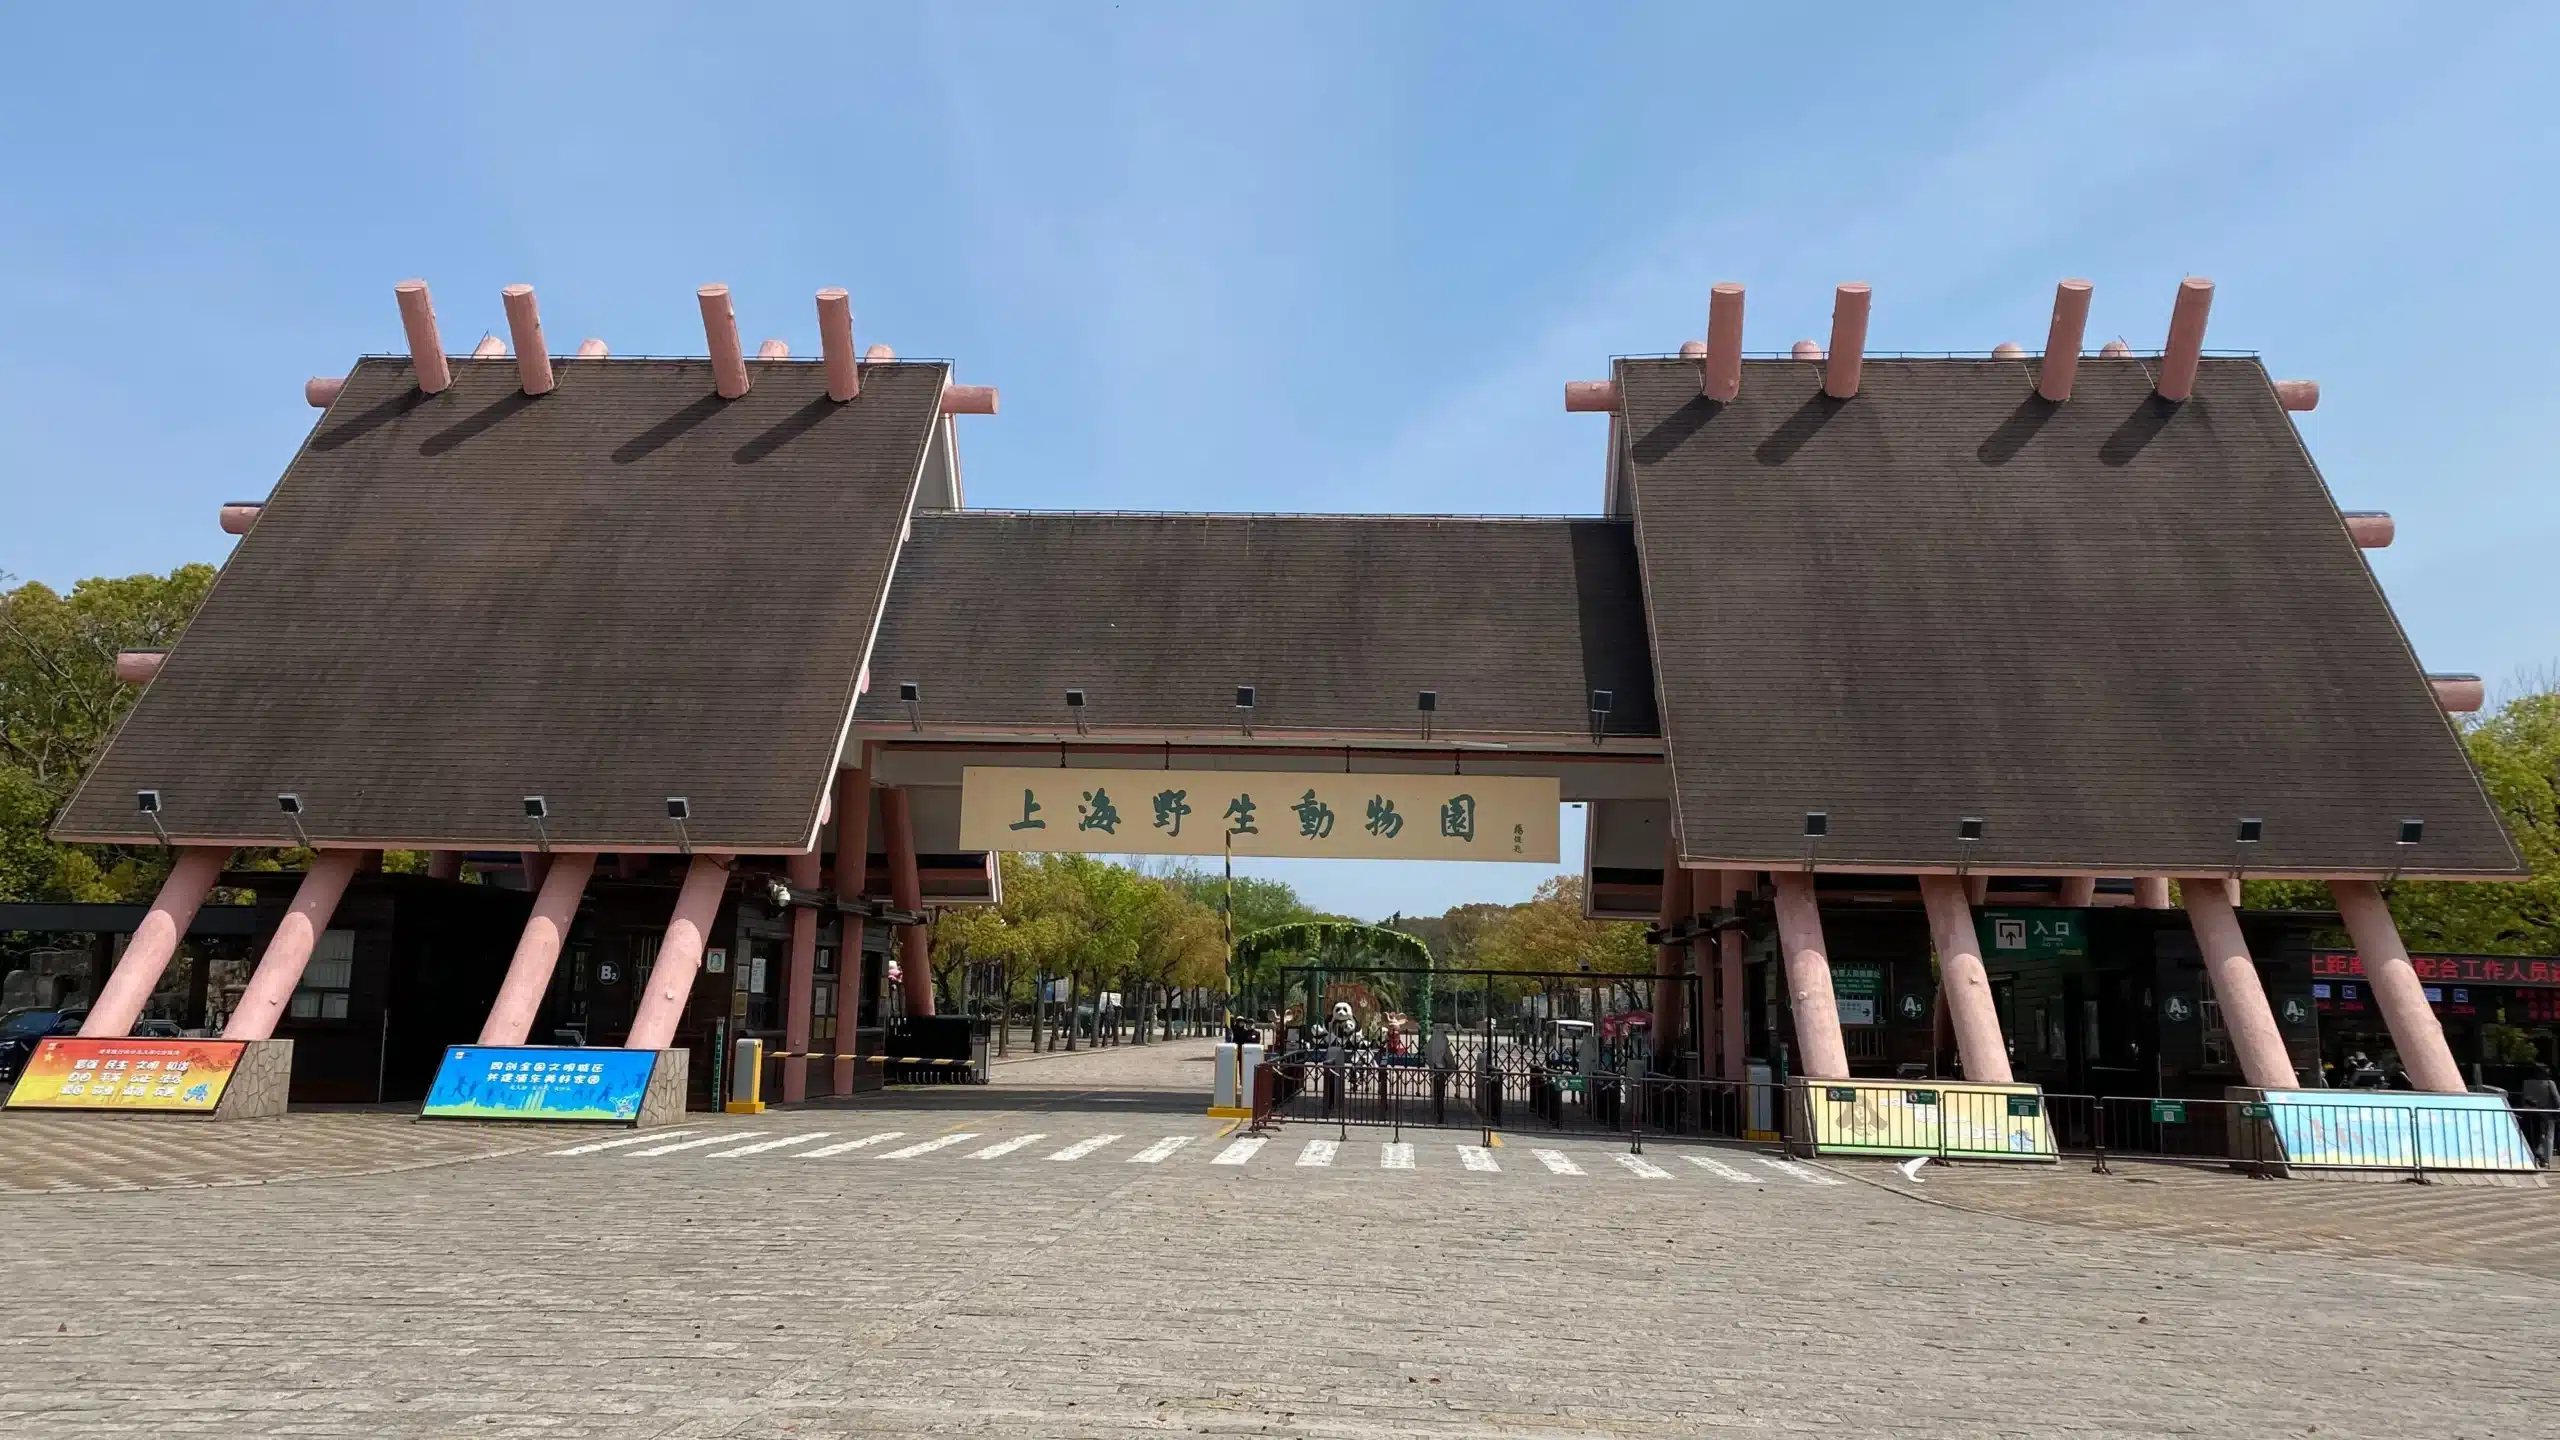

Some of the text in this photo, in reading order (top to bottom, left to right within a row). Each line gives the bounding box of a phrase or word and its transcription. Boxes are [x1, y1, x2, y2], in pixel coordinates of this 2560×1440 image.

[2033, 920, 2070, 936] 入口
[600, 965, 617, 980] B2
[2169, 998, 2188, 1014] A3
[2286, 1000, 2305, 1016] A2
[104, 1059, 129, 1070] 民主
[135, 1060, 161, 1070] 文明
